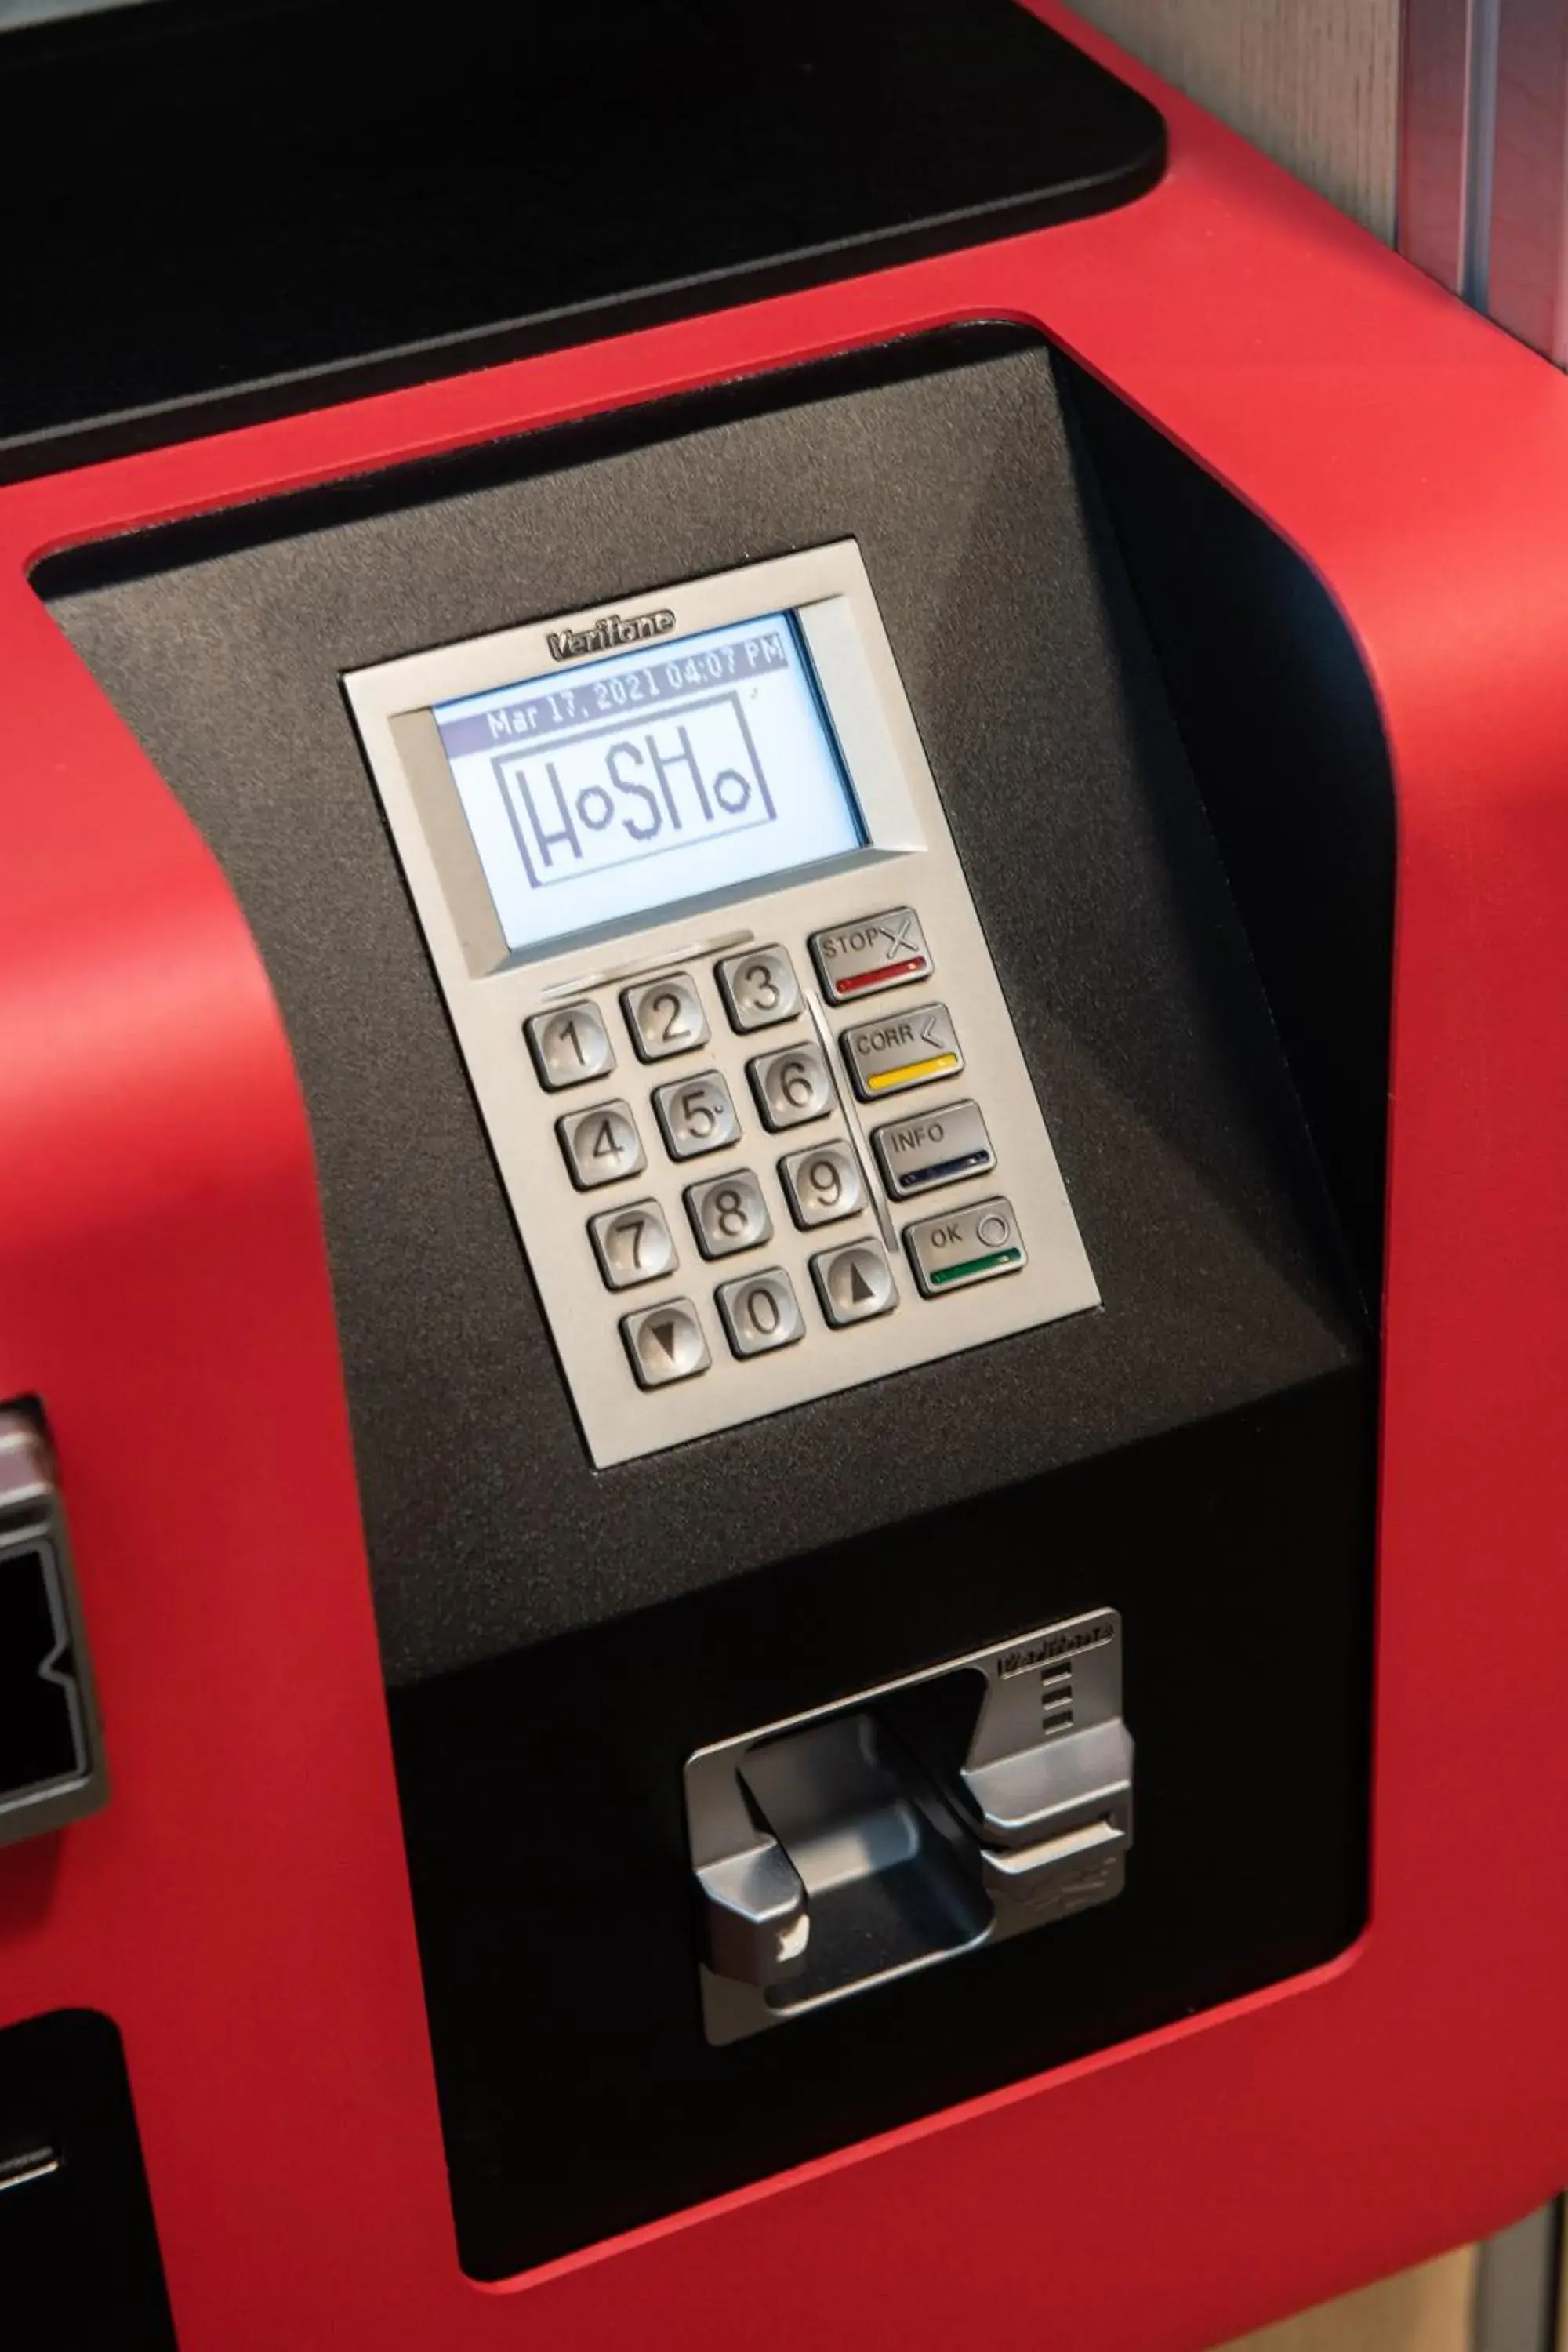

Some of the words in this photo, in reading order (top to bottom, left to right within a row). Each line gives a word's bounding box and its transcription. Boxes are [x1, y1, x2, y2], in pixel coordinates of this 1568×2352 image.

[486, 706, 538, 739] Mar
[549, 690, 590, 723] 17,
[593, 669, 662, 710] 2021
[666, 648, 736, 689] 04:07
[746, 633, 786, 669] PM
[517, 724, 752, 867] HoSHo
[823, 927, 879, 959] STOP
[745, 964, 780, 1011] 3
[652, 993, 691, 1041] 2
[856, 1024, 914, 1056] CORR
[559, 1020, 586, 1066] 1
[779, 1061, 814, 1109] 6
[681, 1090, 716, 1138] 5
[592, 1118, 625, 1163] 4
[891, 1123, 944, 1153] INFO
[808, 1160, 843, 1207] 9
[714, 1189, 749, 1237] 8
[931, 1223, 963, 1249] OK
[615, 1220, 645, 1270] 7
[747, 1288, 780, 1335] 0
